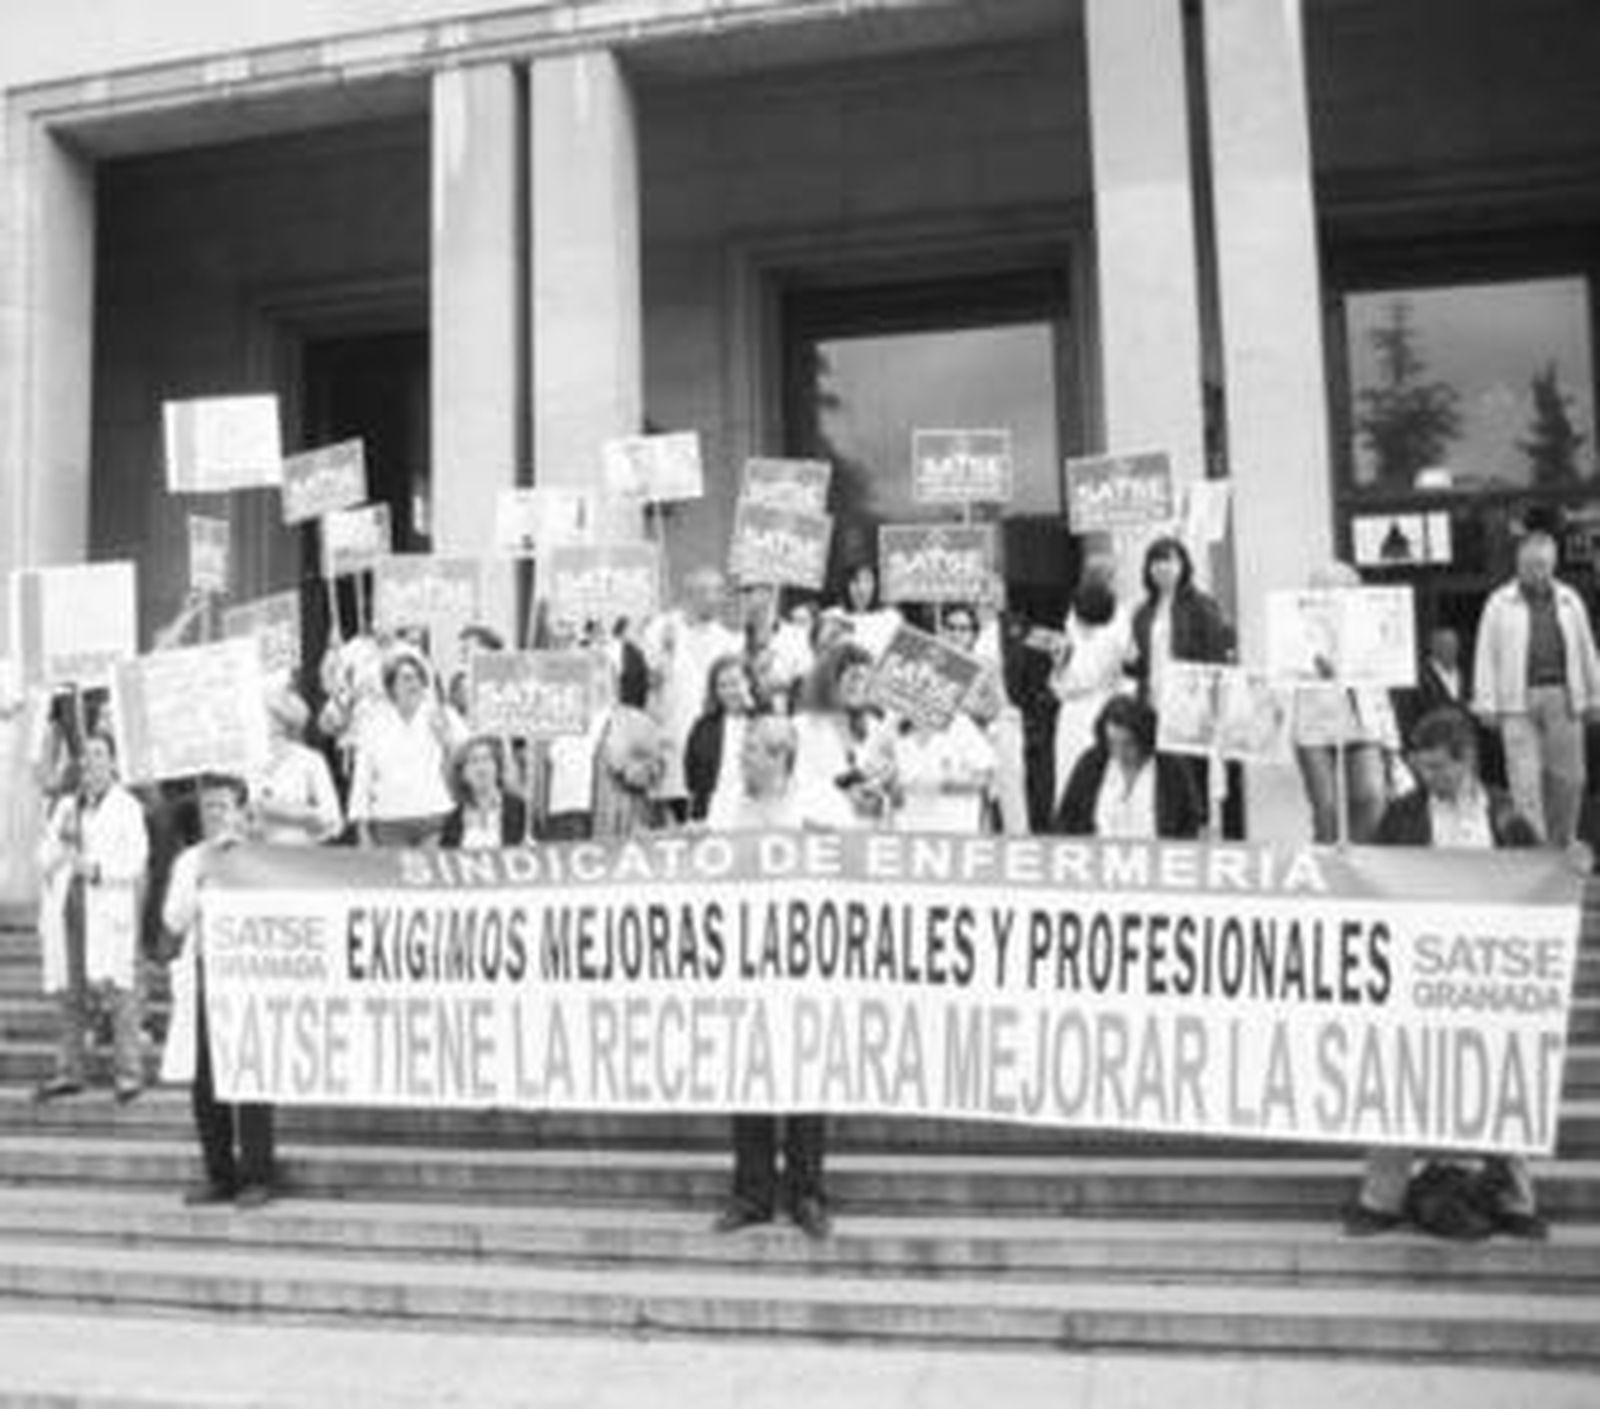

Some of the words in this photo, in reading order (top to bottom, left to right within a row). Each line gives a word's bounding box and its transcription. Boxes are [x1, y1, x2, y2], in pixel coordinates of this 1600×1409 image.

[400, 837, 732, 886] SINDICATO
[760, 834, 842, 878] DE
[211, 915, 326, 951] SATSE
[346, 907, 527, 982] EXIGIMOS
[540, 901, 725, 981] MEJORAS
[738, 899, 975, 985] LABORALES
[992, 908, 1014, 990] Y
[1027, 910, 1393, 1004] PROFESIONALES
[1413, 934, 1566, 979] SATSE
[1412, 980, 1563, 1013] GRANADA
[365, 997, 498, 1096] TIENE
[513, 998, 576, 1099] LA
[589, 997, 774, 1102] RECETA
[792, 999, 930, 1108] PARA
[943, 1006, 1209, 1124] MEJORAR
[1228, 1016, 1300, 1130] LA
